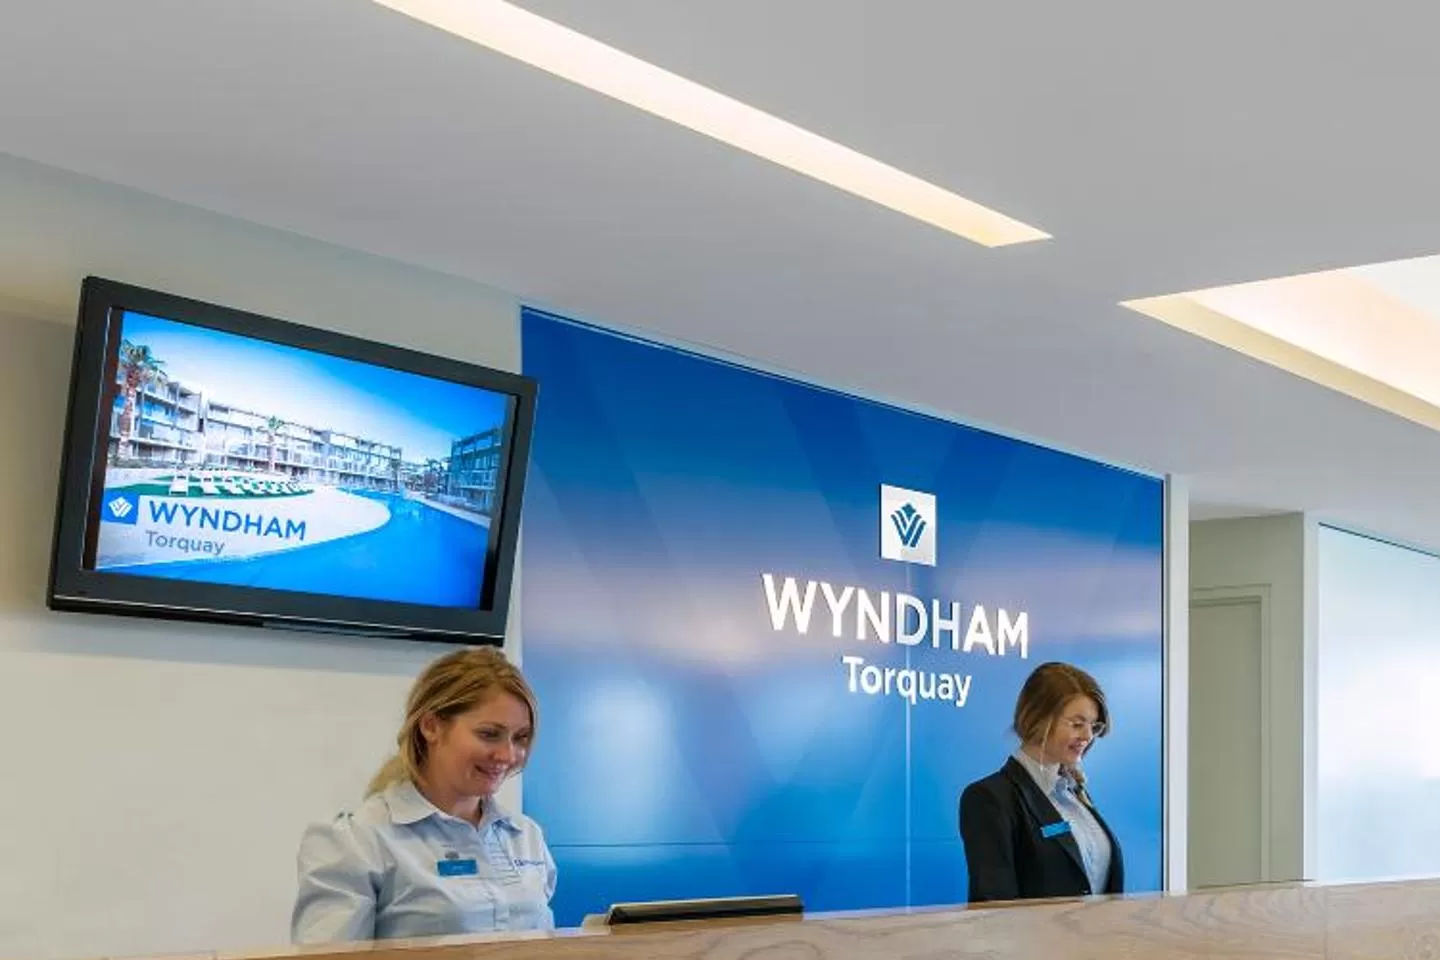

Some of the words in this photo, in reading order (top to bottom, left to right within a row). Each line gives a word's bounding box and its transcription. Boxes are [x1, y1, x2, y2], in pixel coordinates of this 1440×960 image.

[145, 529, 226, 556] Torquay
[149, 500, 307, 541] WYNDHAM
[761, 572, 1029, 660] WYNDHAM
[842, 655, 972, 707] Torquay
